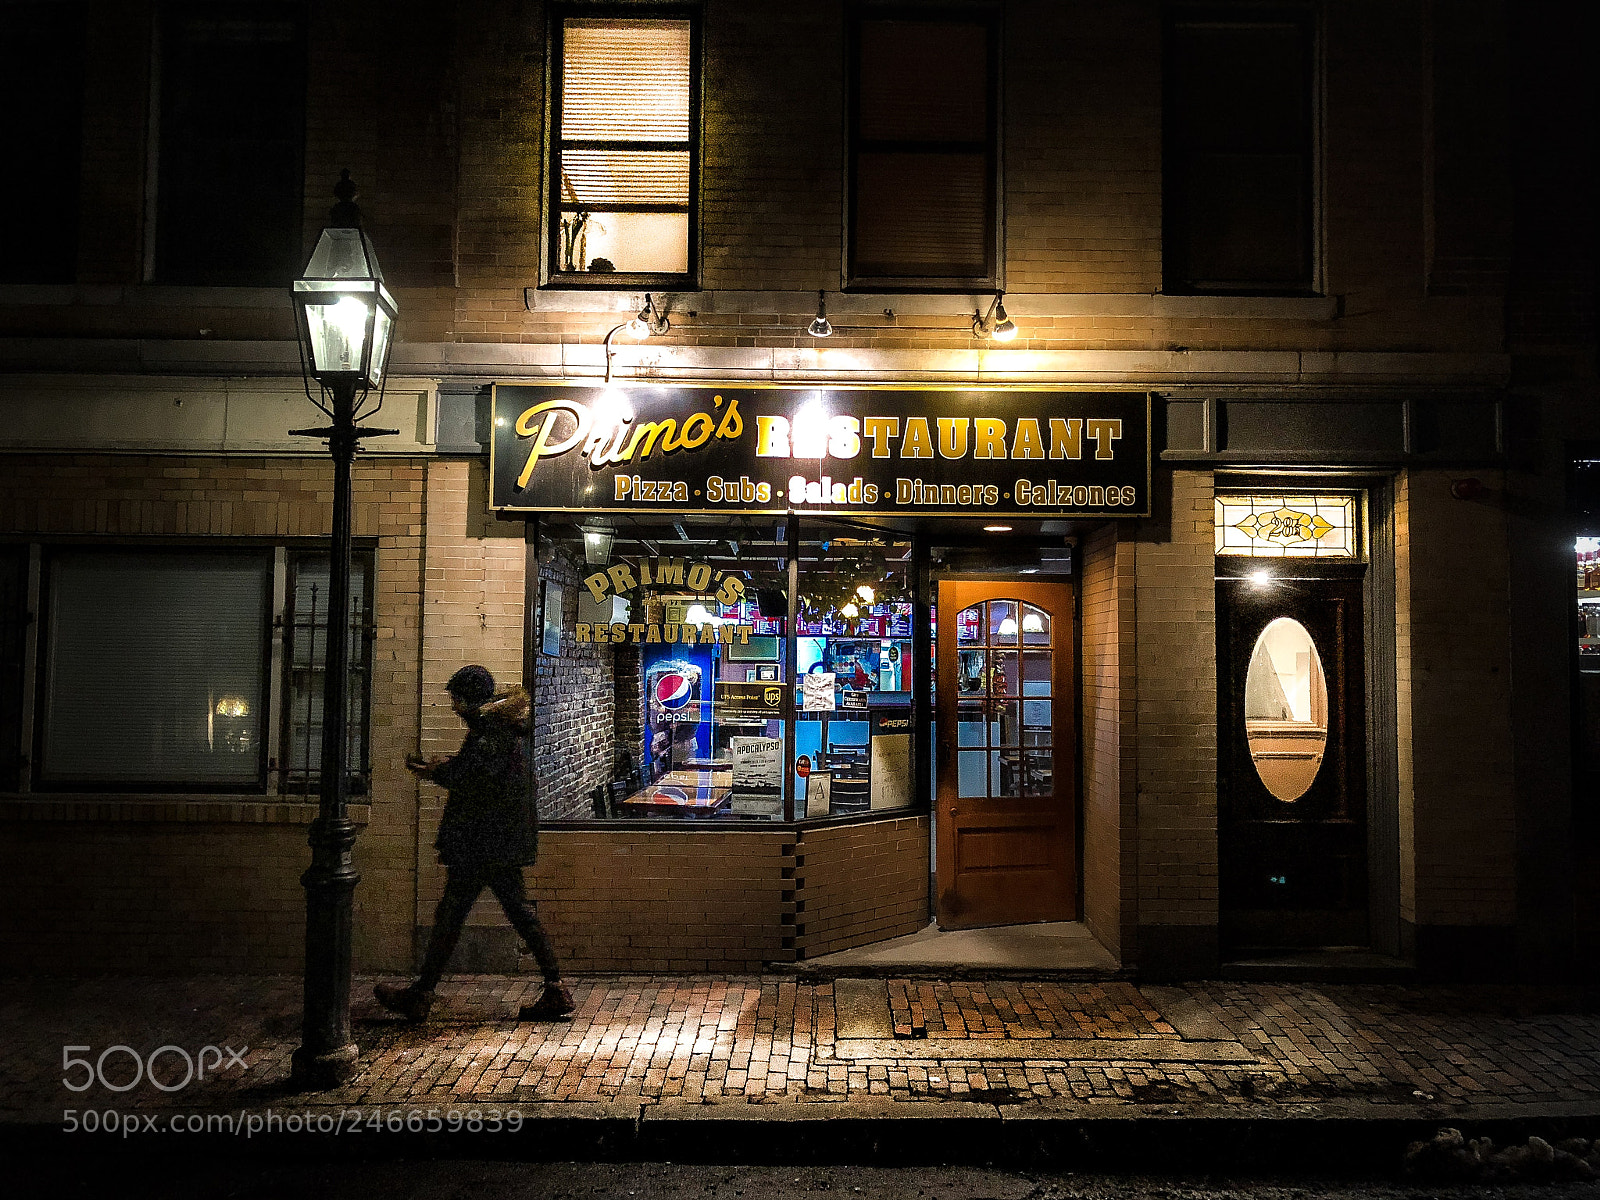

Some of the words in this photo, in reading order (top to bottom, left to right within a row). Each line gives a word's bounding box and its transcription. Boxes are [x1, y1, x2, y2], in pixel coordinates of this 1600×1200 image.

[514, 394, 744, 492] Primo's
[756, 415, 1122, 460] RSTAURANT
[613, 474, 689, 502] Pizza
[706, 475, 772, 503] Subs
[788, 475, 879, 505] Salads
[895, 478, 999, 506] Dinners
[1013, 479, 1137, 507] Calzones
[583, 556, 746, 606] PRIMO'S
[575, 623, 753, 645] RESTAURANT
[766, 692, 779, 704] ups
[887, 719, 909, 728] PEPSI
[736, 741, 780, 755] APOCALYPSO
[814, 780, 825, 800] A
